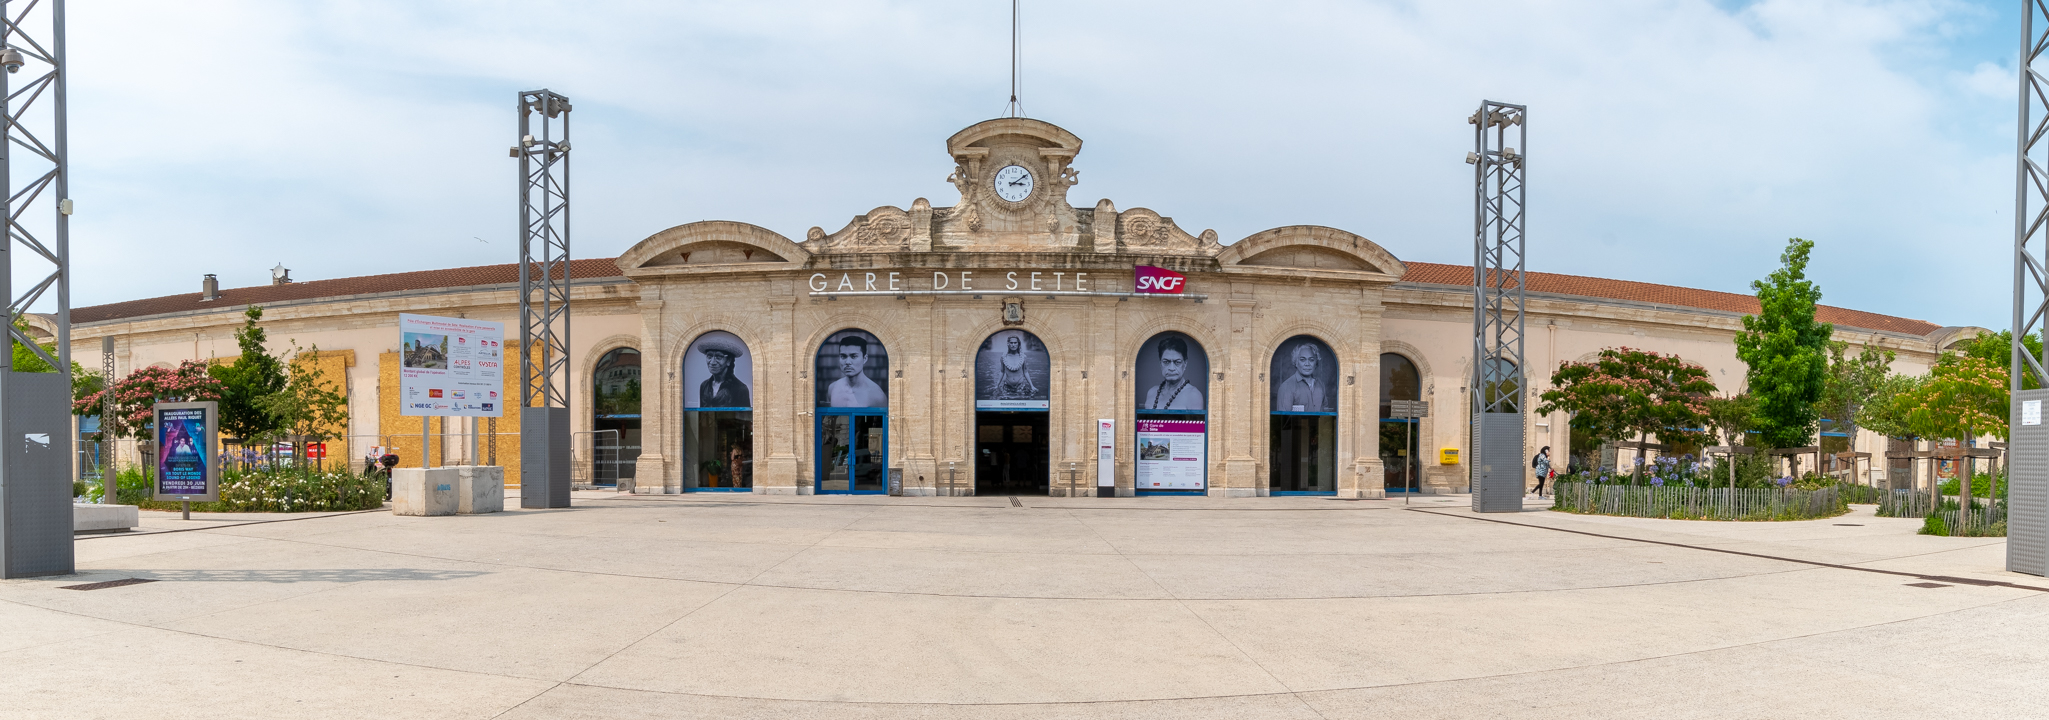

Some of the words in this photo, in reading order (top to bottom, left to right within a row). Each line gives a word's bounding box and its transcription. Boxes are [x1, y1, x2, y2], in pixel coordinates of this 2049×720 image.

[808, 271, 901, 292] GARE
[933, 271, 973, 291] DE
[1005, 271, 1088, 292] SETE
[1136, 275, 1184, 291] SNCF
